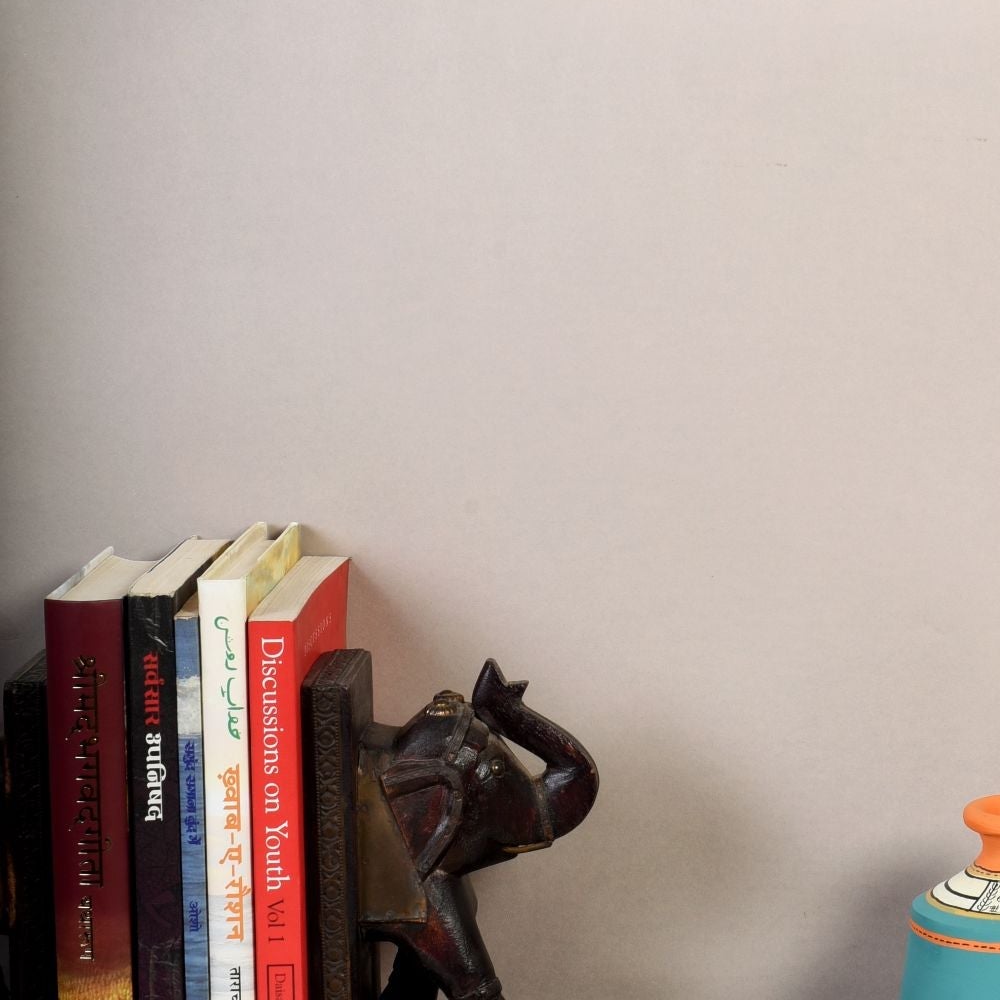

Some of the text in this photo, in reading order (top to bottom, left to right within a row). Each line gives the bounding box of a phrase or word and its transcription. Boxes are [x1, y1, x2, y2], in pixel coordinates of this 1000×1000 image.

[261, 636, 285, 775] Discussions
[144, 731, 167, 822] उपनिषद
[184, 775, 197, 814] समाना
[264, 782, 280, 814] on
[187, 833, 201, 846] में
[265, 820, 291, 892] Youth
[187, 900, 201, 933] ओशो
[267, 899, 286, 935] Vol
